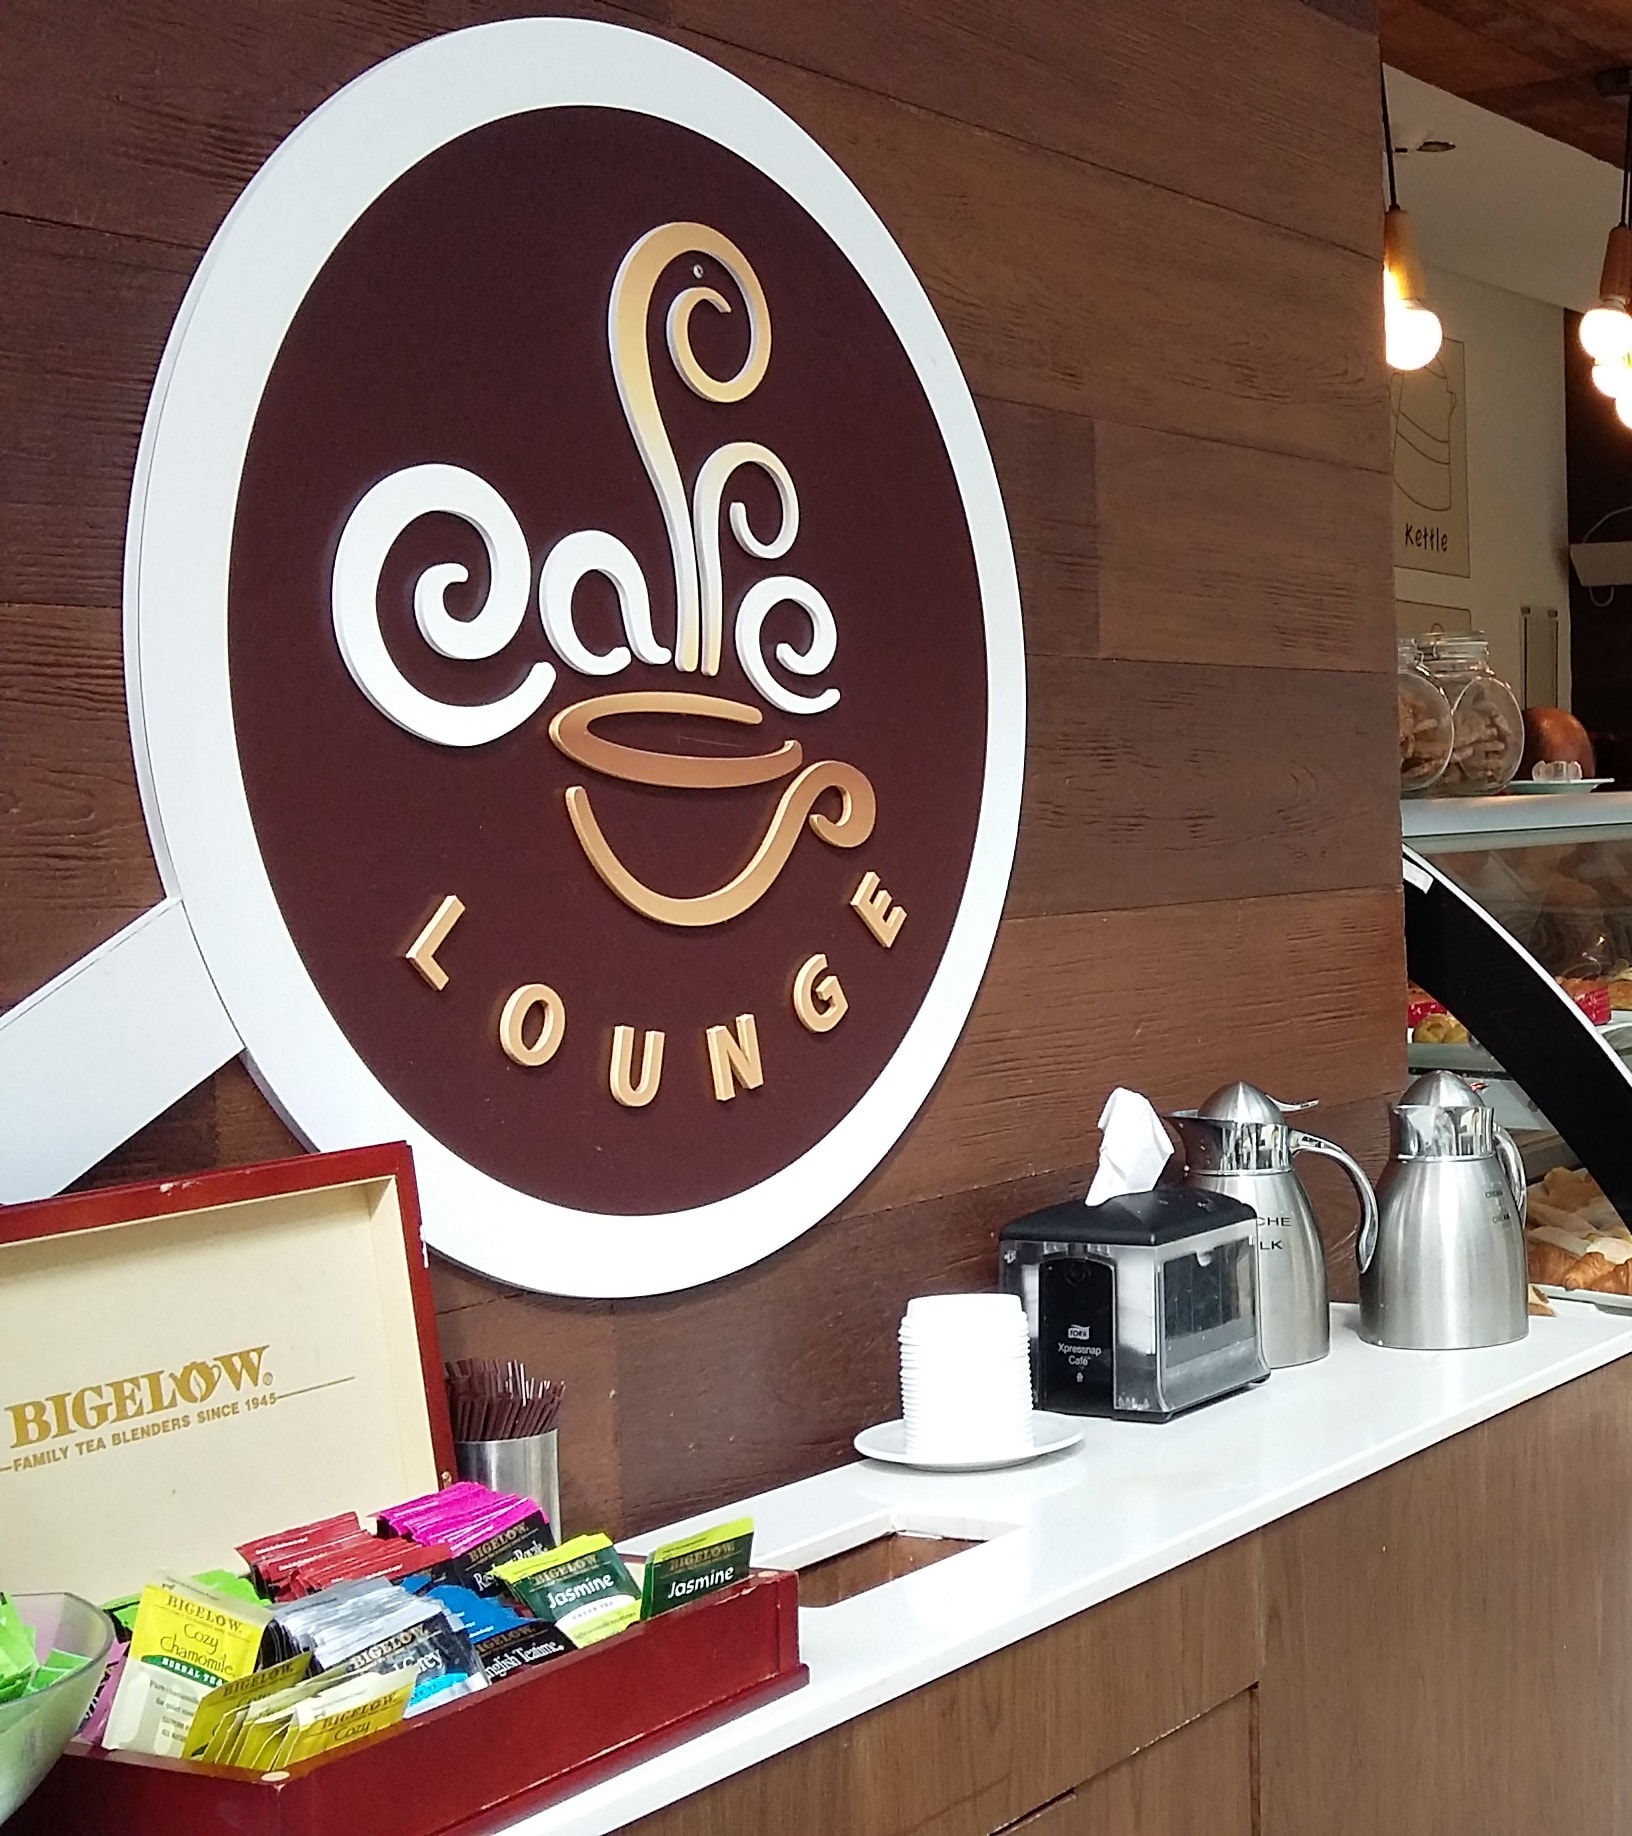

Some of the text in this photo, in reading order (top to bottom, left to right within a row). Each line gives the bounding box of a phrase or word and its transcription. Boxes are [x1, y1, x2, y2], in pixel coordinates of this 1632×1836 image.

[1404, 523, 1448, 552] Kettle
[405, 870, 908, 1108] LOUNGE
[1257, 1216, 1291, 1226] CHE
[1260, 1240, 1283, 1250] LK
[13, 1392, 278, 1471] FAMILY TEA BLENDERS SINCE 1945
[546, 1573, 614, 1609] Jasmine
[668, 1566, 734, 1599] Jasmine
[184, 1622, 219, 1655] Cozy
[476, 1626, 533, 1653] IGELOW
[160, 1633, 233, 1676] Chamomile
[484, 1647, 523, 1677] nglish
[334, 1720, 371, 1741] Cozy
